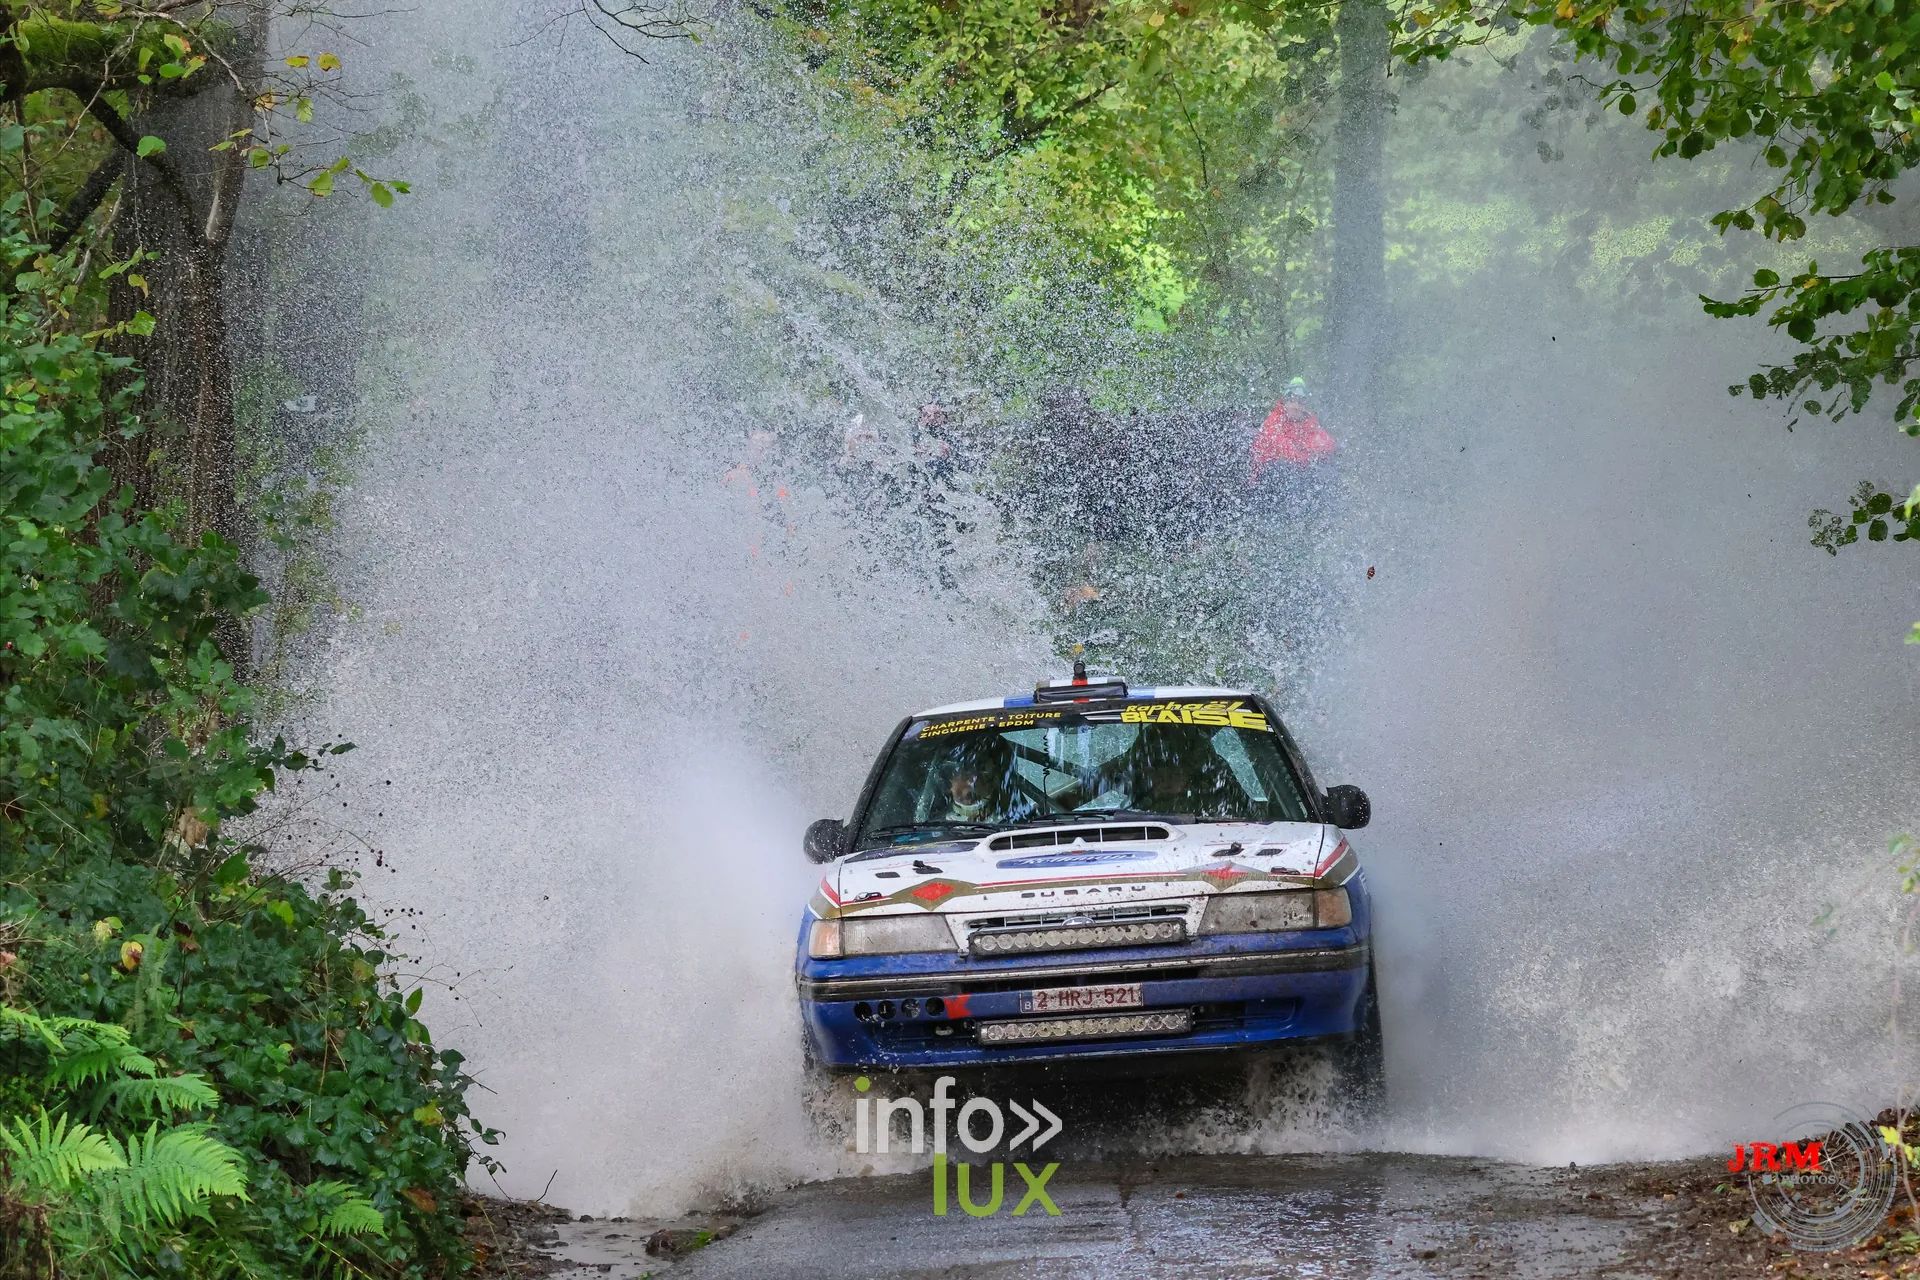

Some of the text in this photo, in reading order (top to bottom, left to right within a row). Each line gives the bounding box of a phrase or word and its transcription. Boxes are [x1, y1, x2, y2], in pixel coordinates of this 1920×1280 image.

[919, 720, 1034, 739] ZINGUERIE EPDM
[922, 712, 1062, 732] CHARPENTE TOITURE
[1120, 709, 1268, 731] BLAISE
[1020, 885, 1146, 899] SUBARU
[1024, 1001, 1032, 1010] B
